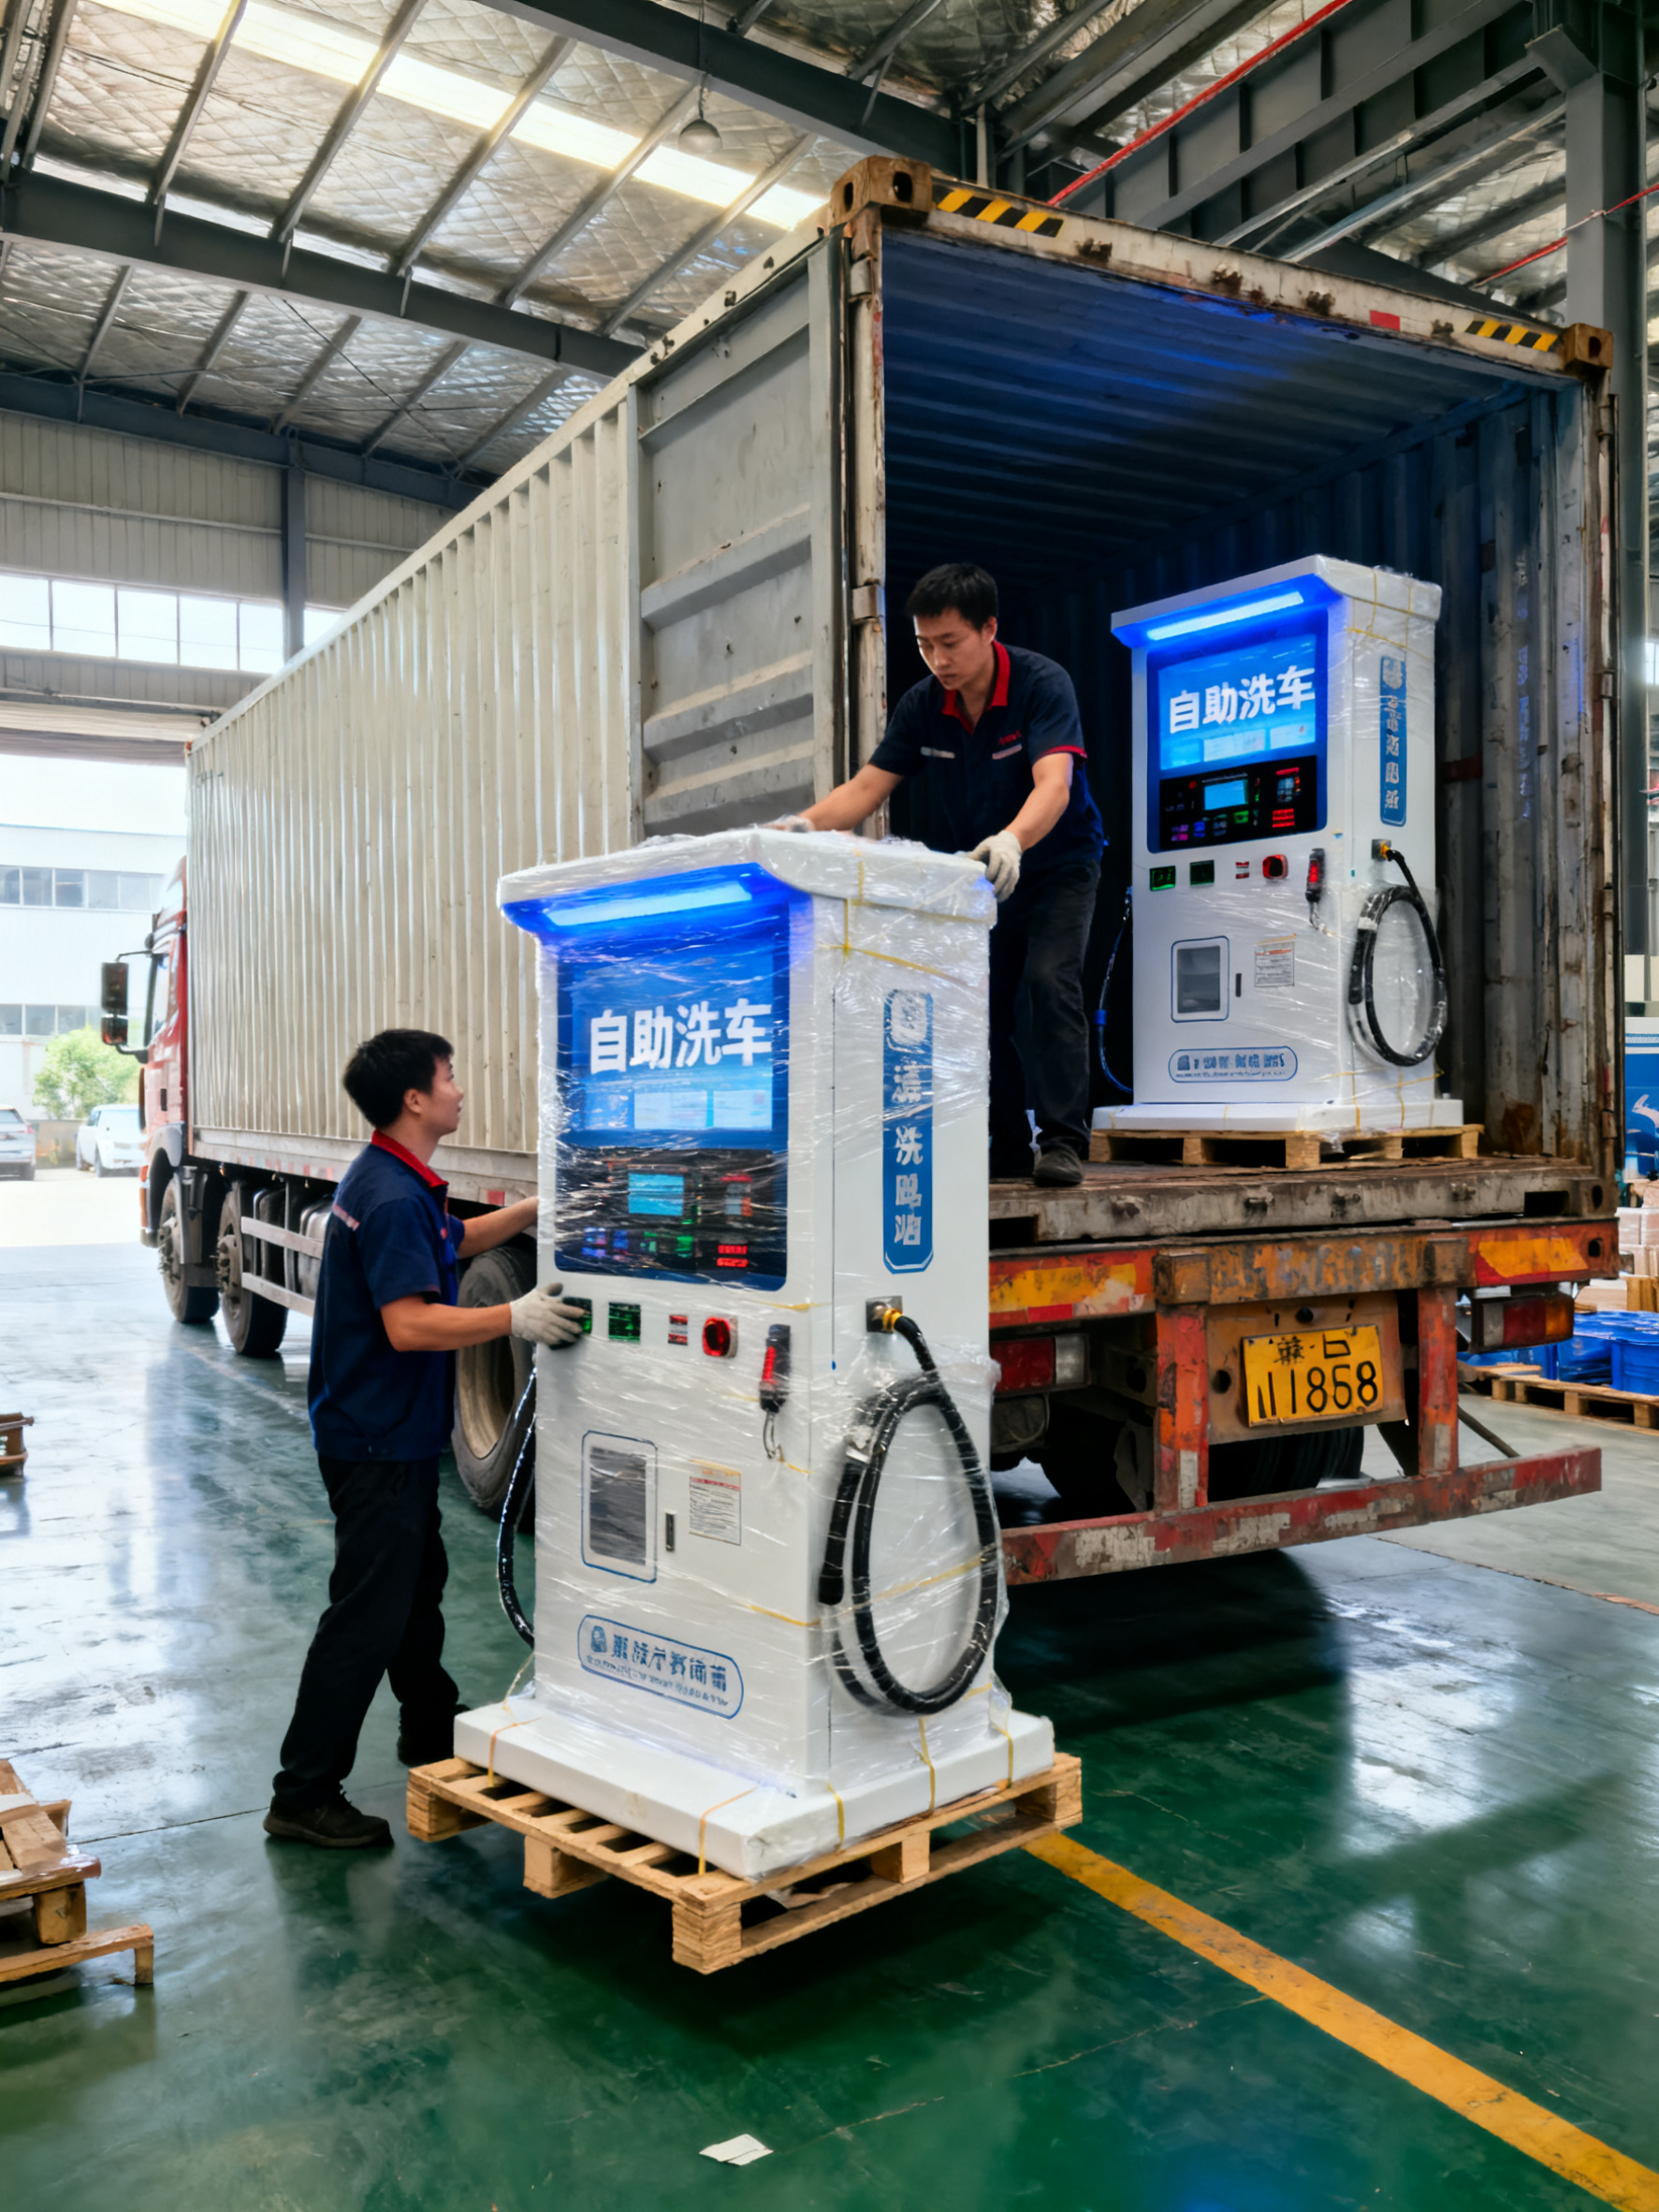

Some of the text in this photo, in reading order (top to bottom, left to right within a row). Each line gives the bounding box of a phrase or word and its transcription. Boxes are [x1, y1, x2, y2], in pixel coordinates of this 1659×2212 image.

[1170, 665, 1316, 735] 自助洗车
[589, 997, 773, 1074] 自助洗车
